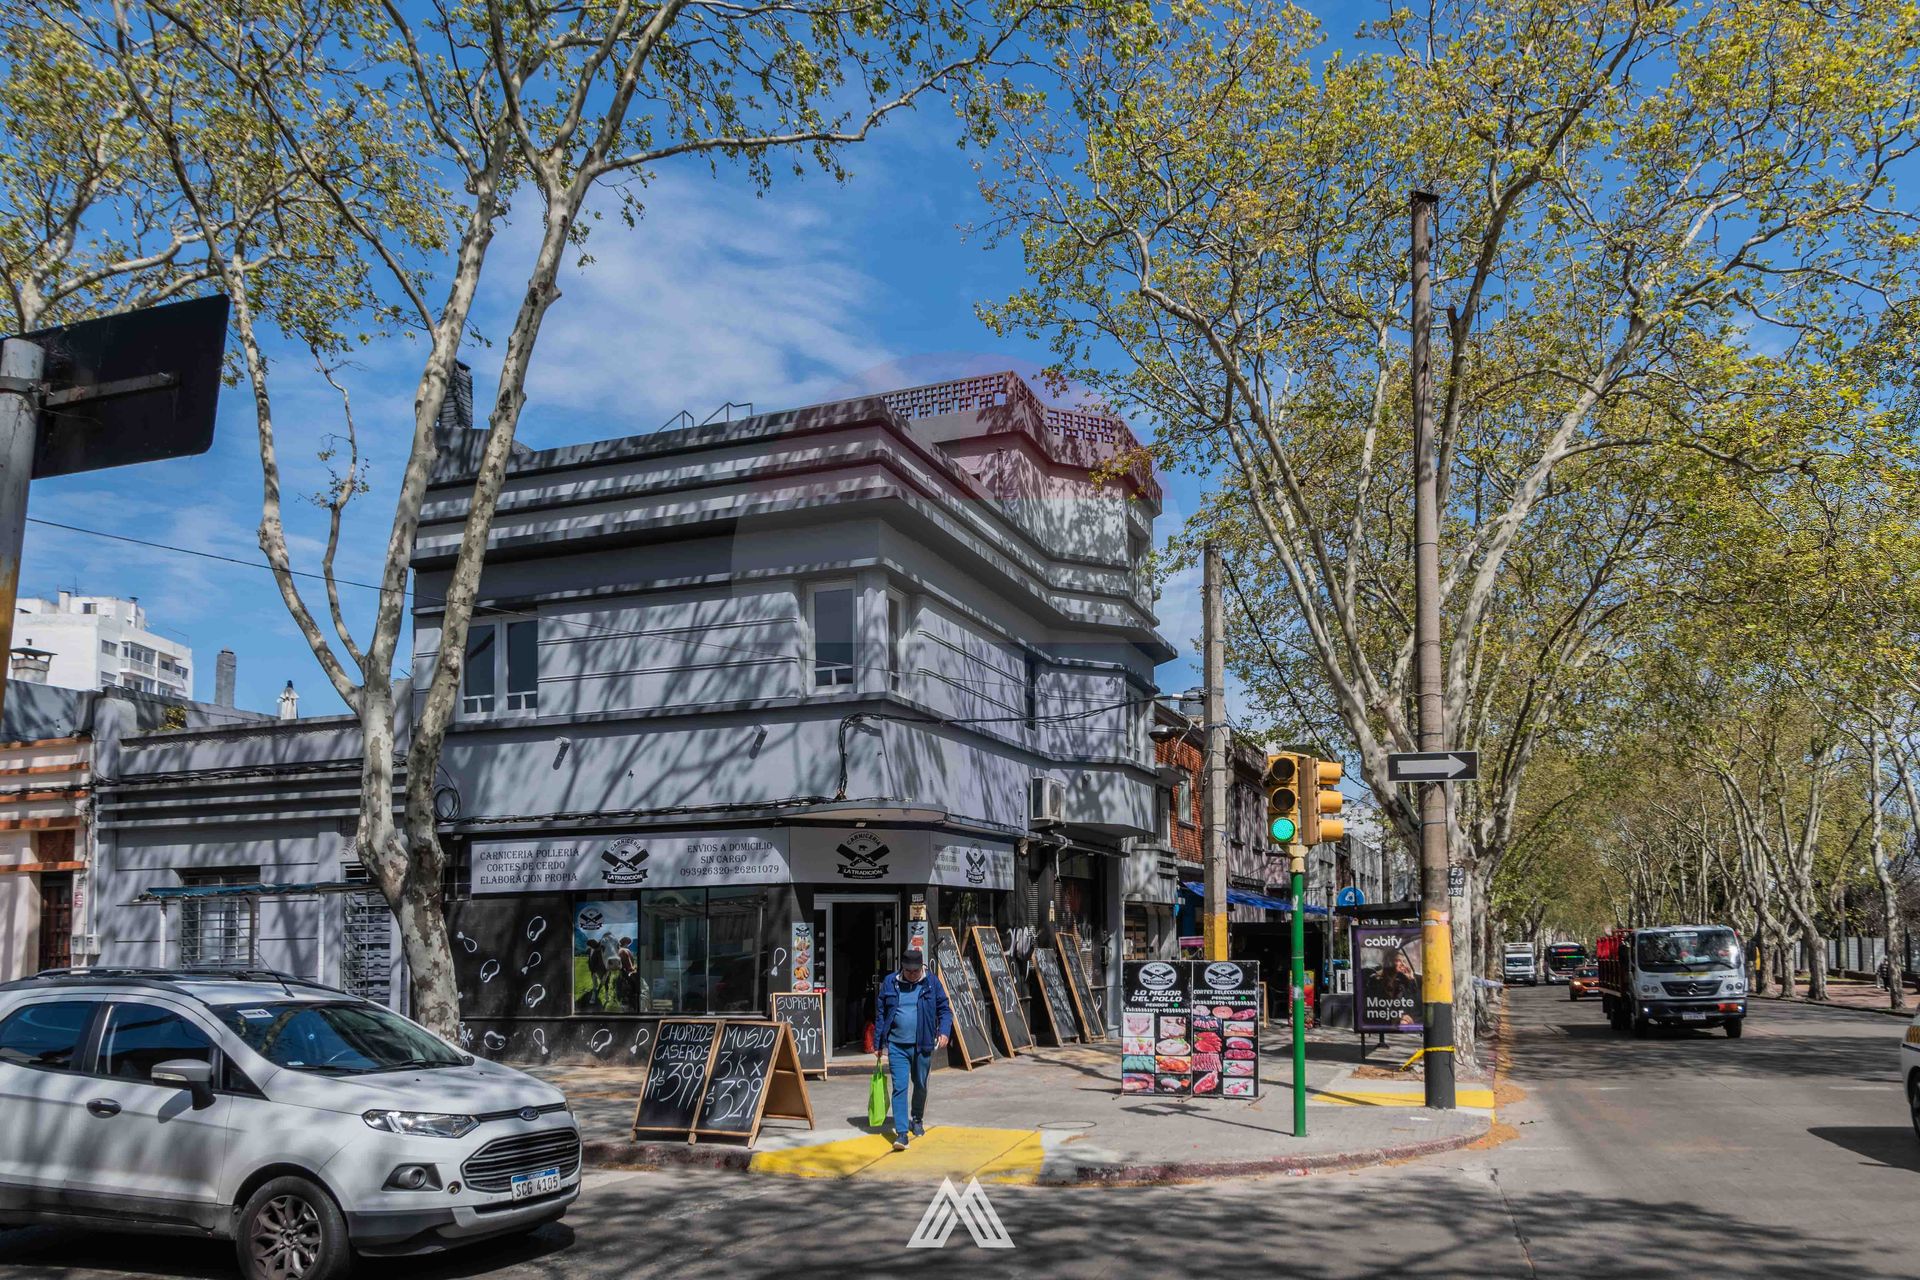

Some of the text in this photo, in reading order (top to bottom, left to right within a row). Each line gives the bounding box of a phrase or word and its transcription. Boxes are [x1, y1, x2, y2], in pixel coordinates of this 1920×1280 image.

[720, 843, 726, 851] A
[729, 842, 773, 851] DOMICILIO
[480, 848, 579, 860] CARNICERIA POLLERIA
[700, 854, 747, 864] SIN CARGO
[487, 861, 566, 872] CORTES DE CERDO
[545, 872, 577, 882] PROPIA
[1364, 935, 1402, 949] cabify
[776, 996, 820, 1011] SUPREMA
[1366, 996, 1415, 1008] Movete
[1366, 1007, 1404, 1021] mejor
[721, 1026, 775, 1050] MUSLO
[654, 1044, 710, 1061] CASEROS
[515, 1175, 559, 1198] SCG 4105
